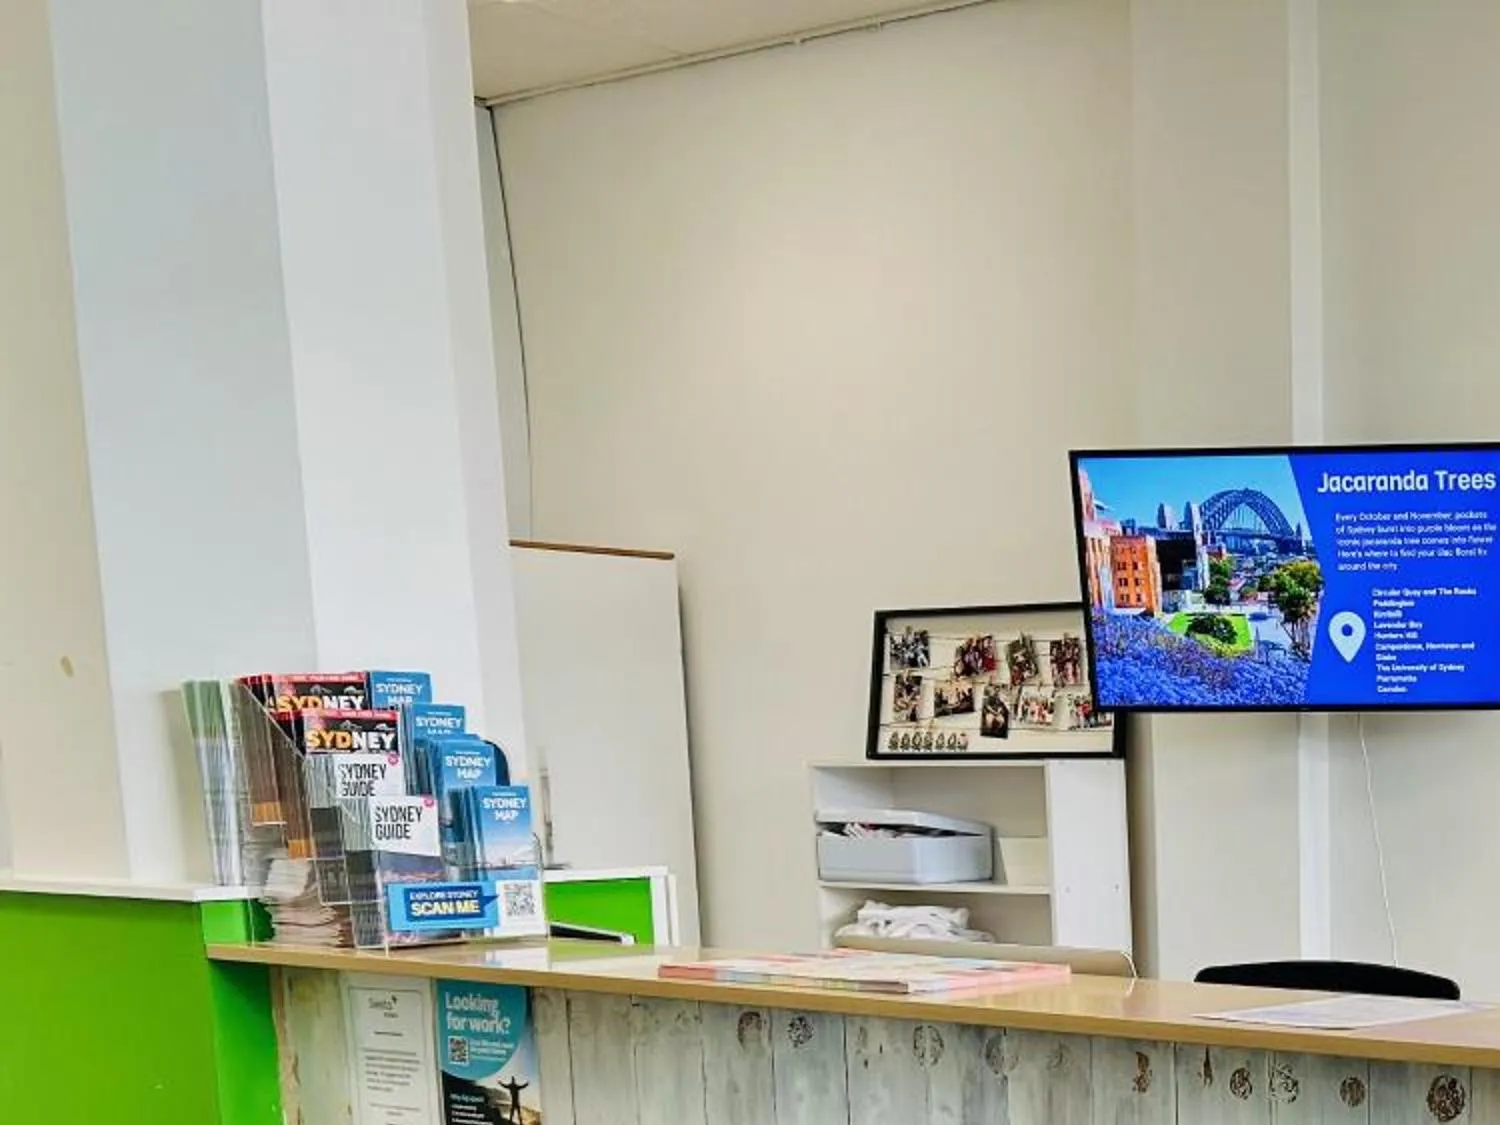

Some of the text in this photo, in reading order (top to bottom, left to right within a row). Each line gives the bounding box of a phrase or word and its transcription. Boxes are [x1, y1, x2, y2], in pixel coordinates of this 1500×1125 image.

[1317, 470, 1497, 493] Jacaranda Trees
[1335, 513, 1357, 523] Every
[1359, 512, 1391, 522] October
[1394, 512, 1408, 521] and
[1346, 525, 1376, 535] Sydney
[1417, 525, 1443, 535] purple
[1423, 587, 1437, 596] and
[1461, 642, 1475, 650] and
[1376, 663, 1465, 673] The University of Sydney
[376, 683, 423, 695] SYDNEY
[274, 694, 365, 711] SYDNEY
[415, 717, 463, 728] SYDNEY
[305, 730, 396, 750] SYDNEY
[445, 755, 492, 767] SYDNEY
[338, 763, 387, 780] SYDNEY
[457, 768, 483, 779] MAP
[341, 780, 376, 797] GUIDE
[483, 797, 527, 809] SYDNEY
[375, 805, 423, 823] SYDNEY
[495, 810, 519, 822] MAP
[375, 823, 411, 840] GUIDE
[447, 890, 479, 899] SYDNEY
[410, 899, 481, 916] SCAN ME
[445, 991, 500, 1019] Looking
[446, 1011, 512, 1036] for work?
